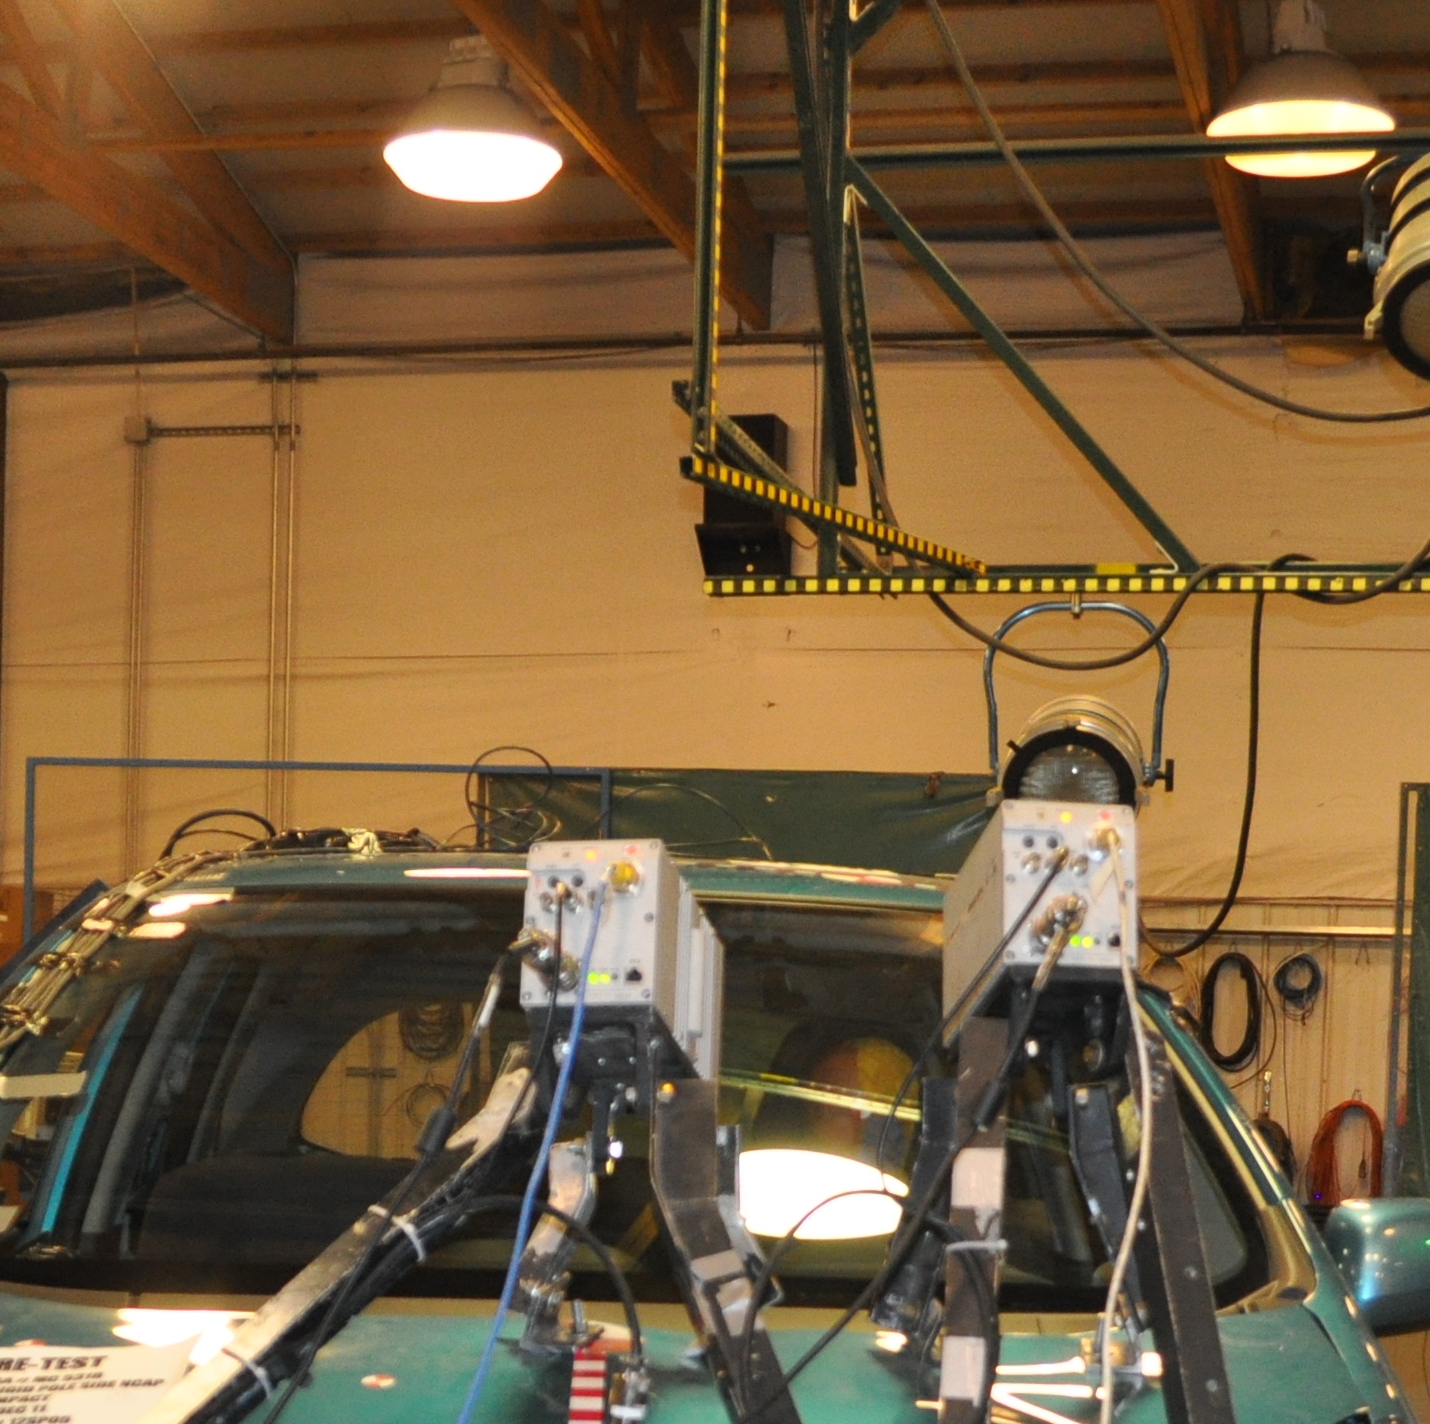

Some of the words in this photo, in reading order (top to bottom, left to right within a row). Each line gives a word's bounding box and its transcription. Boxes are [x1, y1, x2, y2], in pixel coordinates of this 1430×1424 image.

[37, 1382, 78, 1392] POLE
[79, 1380, 116, 1390] SIDE
[119, 1378, 165, 1388] NCAP
